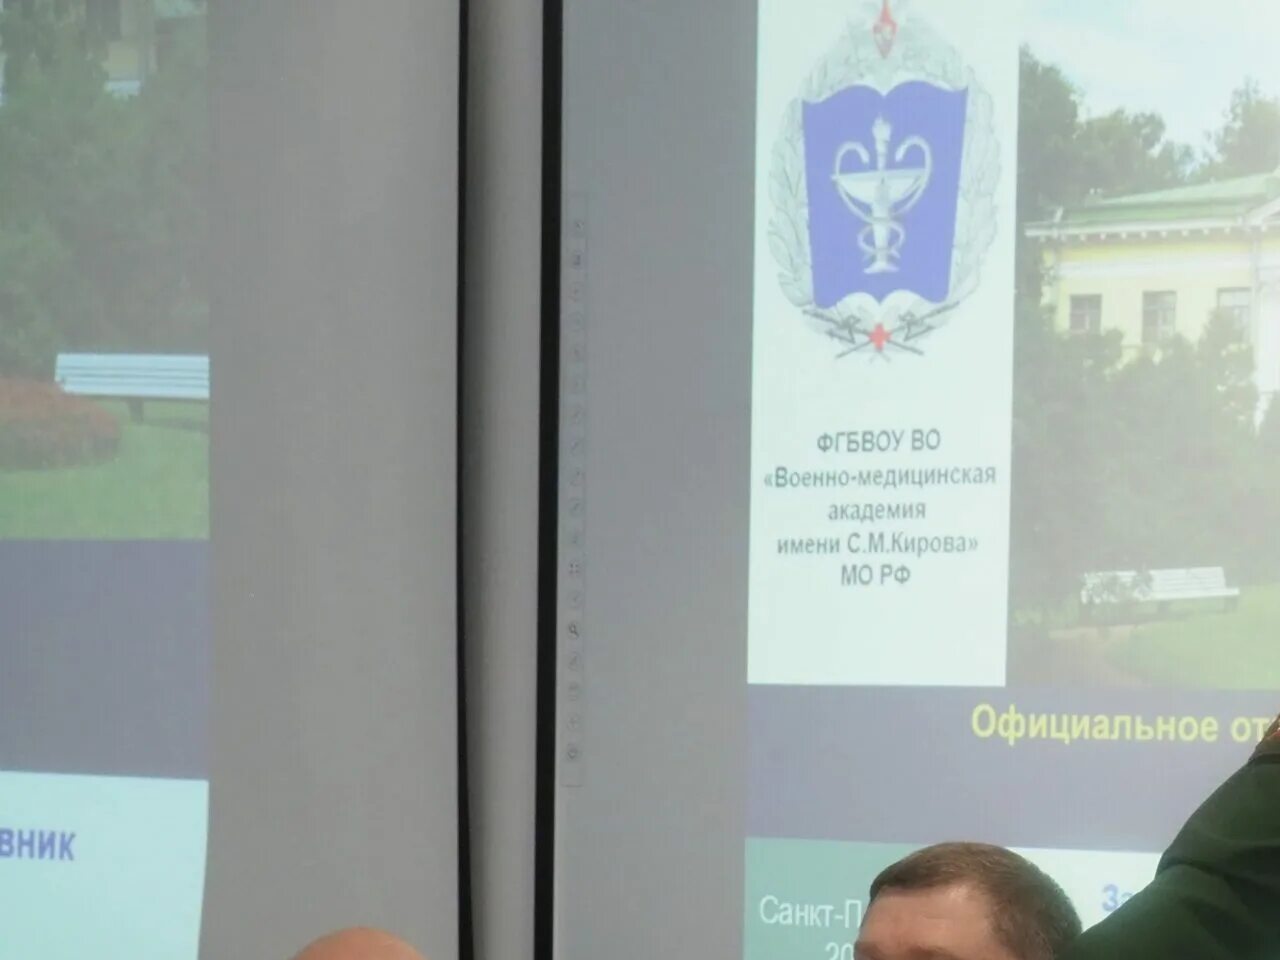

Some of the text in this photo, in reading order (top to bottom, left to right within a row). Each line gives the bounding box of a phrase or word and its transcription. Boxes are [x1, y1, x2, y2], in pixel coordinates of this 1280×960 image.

[817, 429, 941, 452] ФГБВОУ ВО
[764, 465, 996, 489] «Военно-медицинская
[828, 502, 926, 522] академия
[777, 532, 978, 557] имени С.М.Кирова»
[841, 564, 911, 586] МО РФ
[971, 703, 1218, 746] Официальное
[760, 895, 862, 928] Санкт-П
